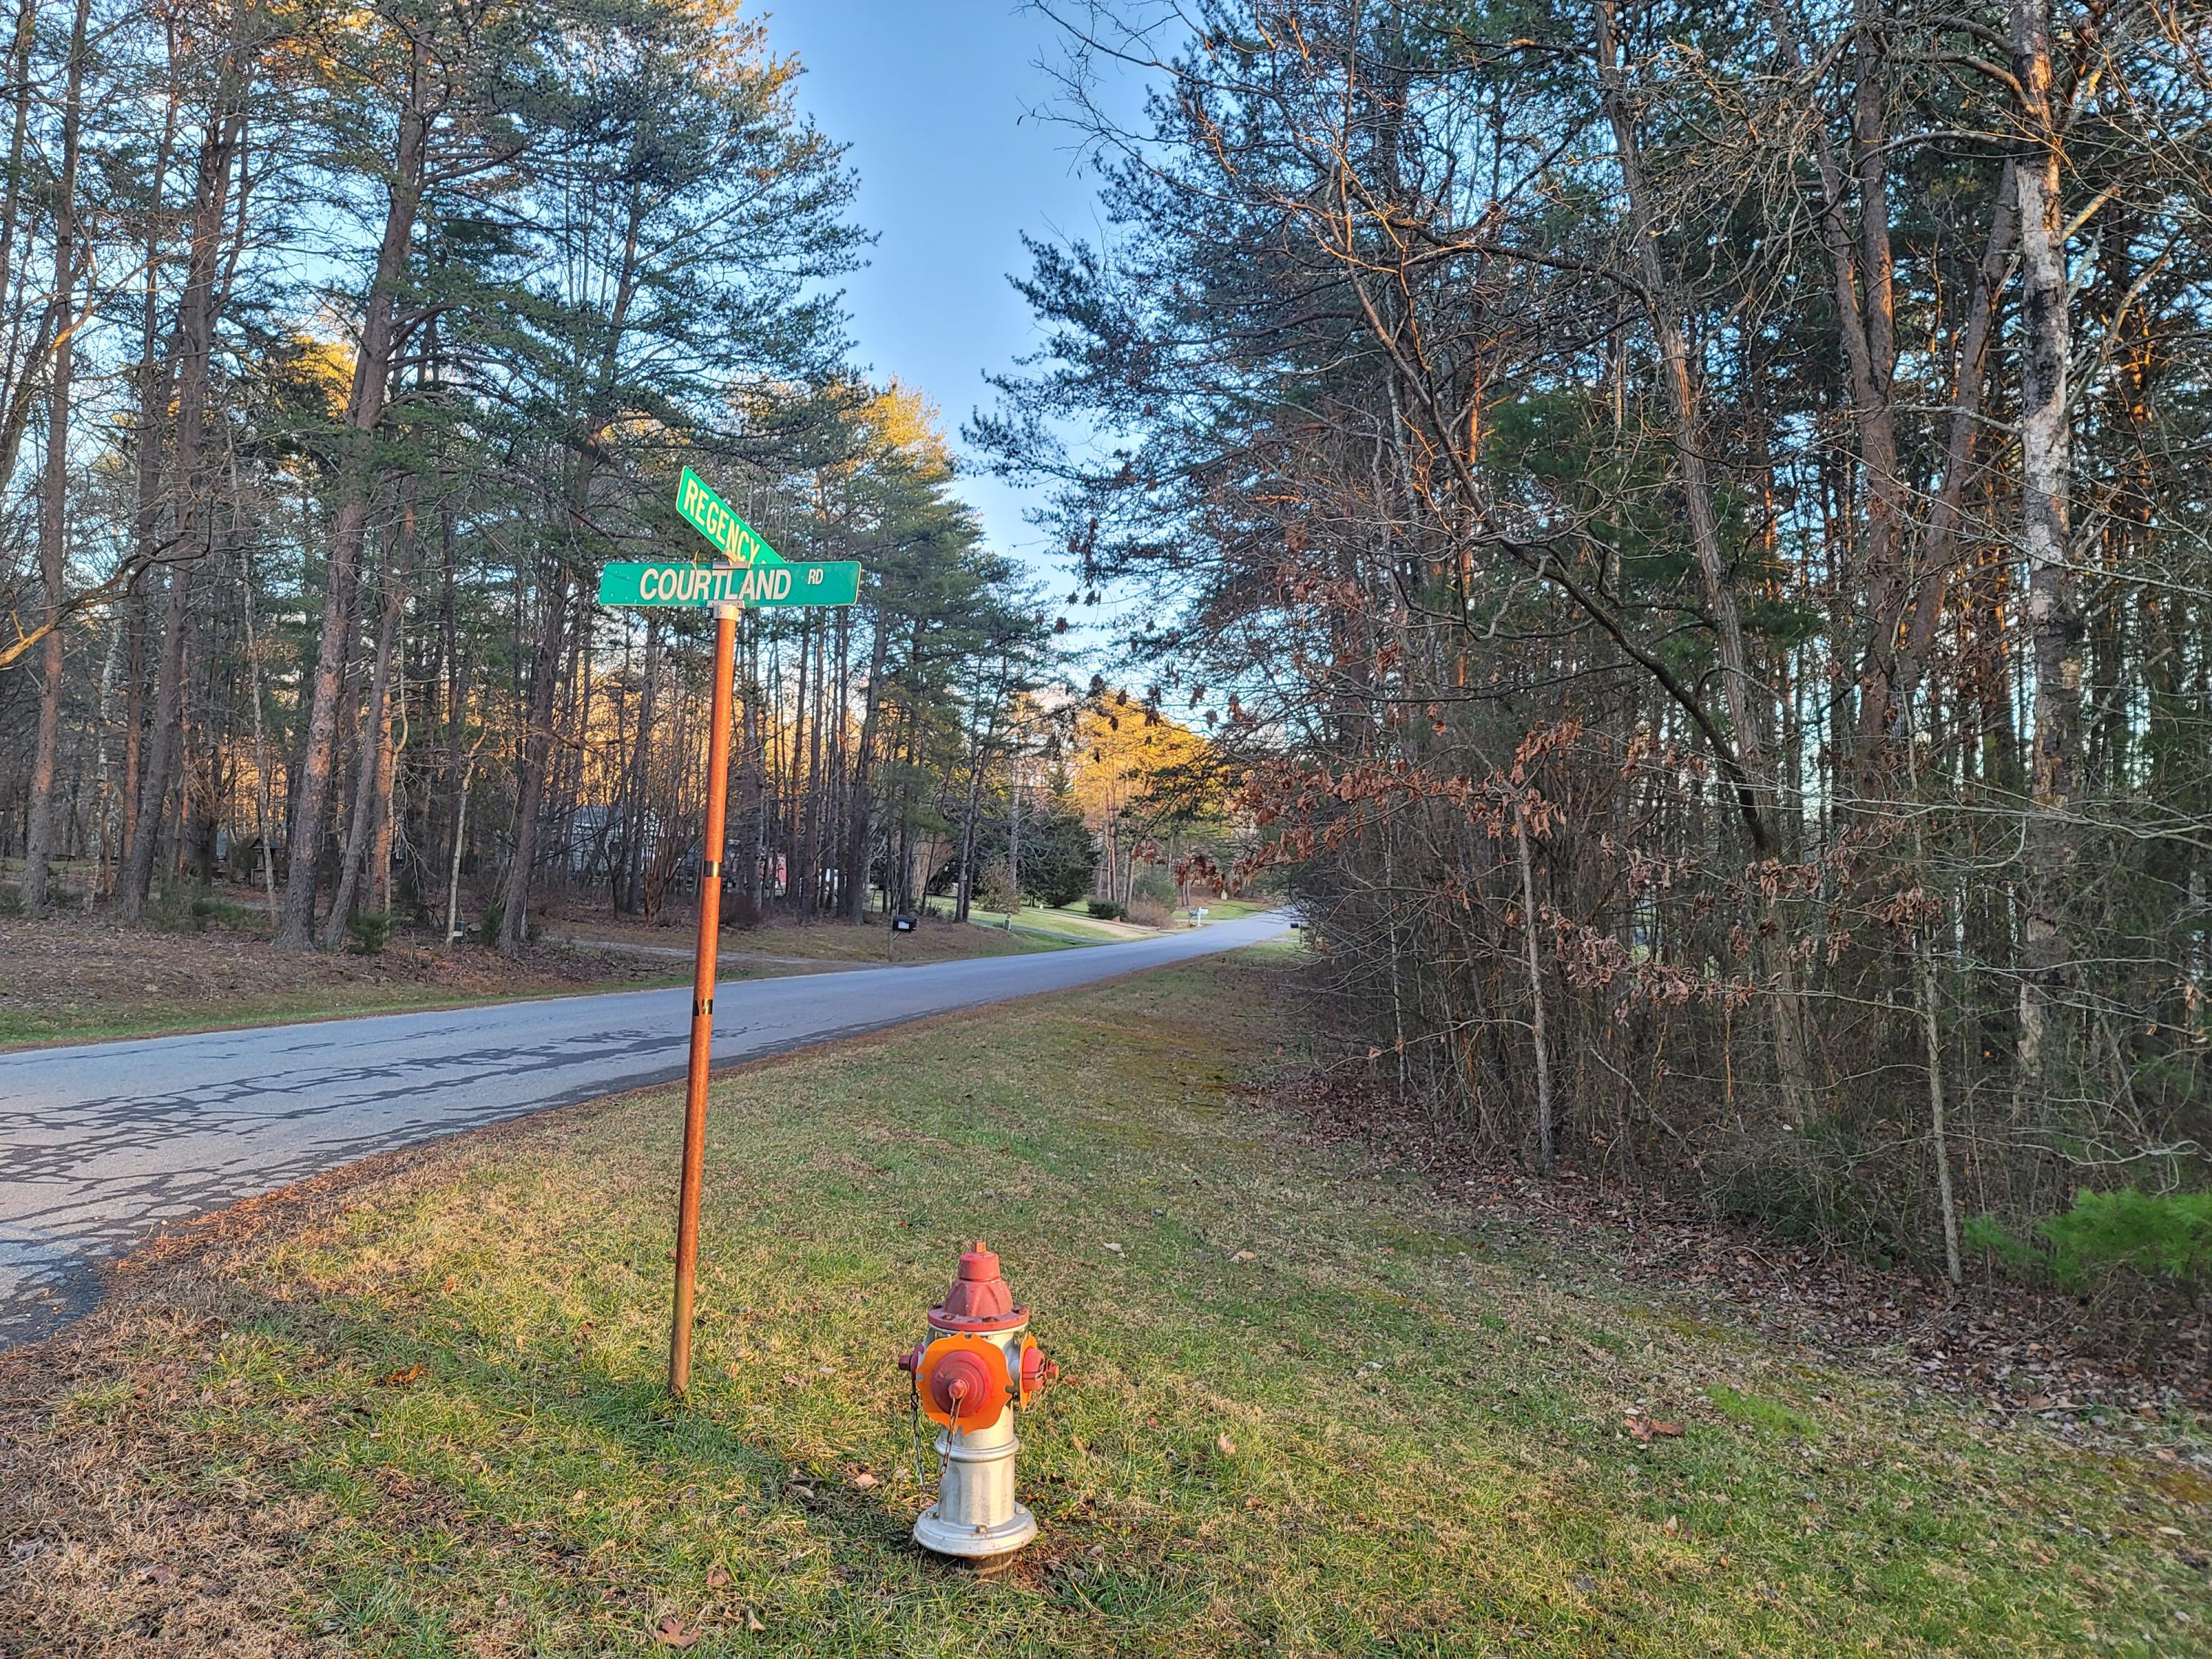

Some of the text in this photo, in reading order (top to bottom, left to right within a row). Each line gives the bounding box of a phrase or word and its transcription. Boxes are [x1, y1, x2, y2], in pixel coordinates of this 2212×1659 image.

[684, 477, 760, 566] REGENCY
[639, 568, 824, 601] COURTLAND RD
